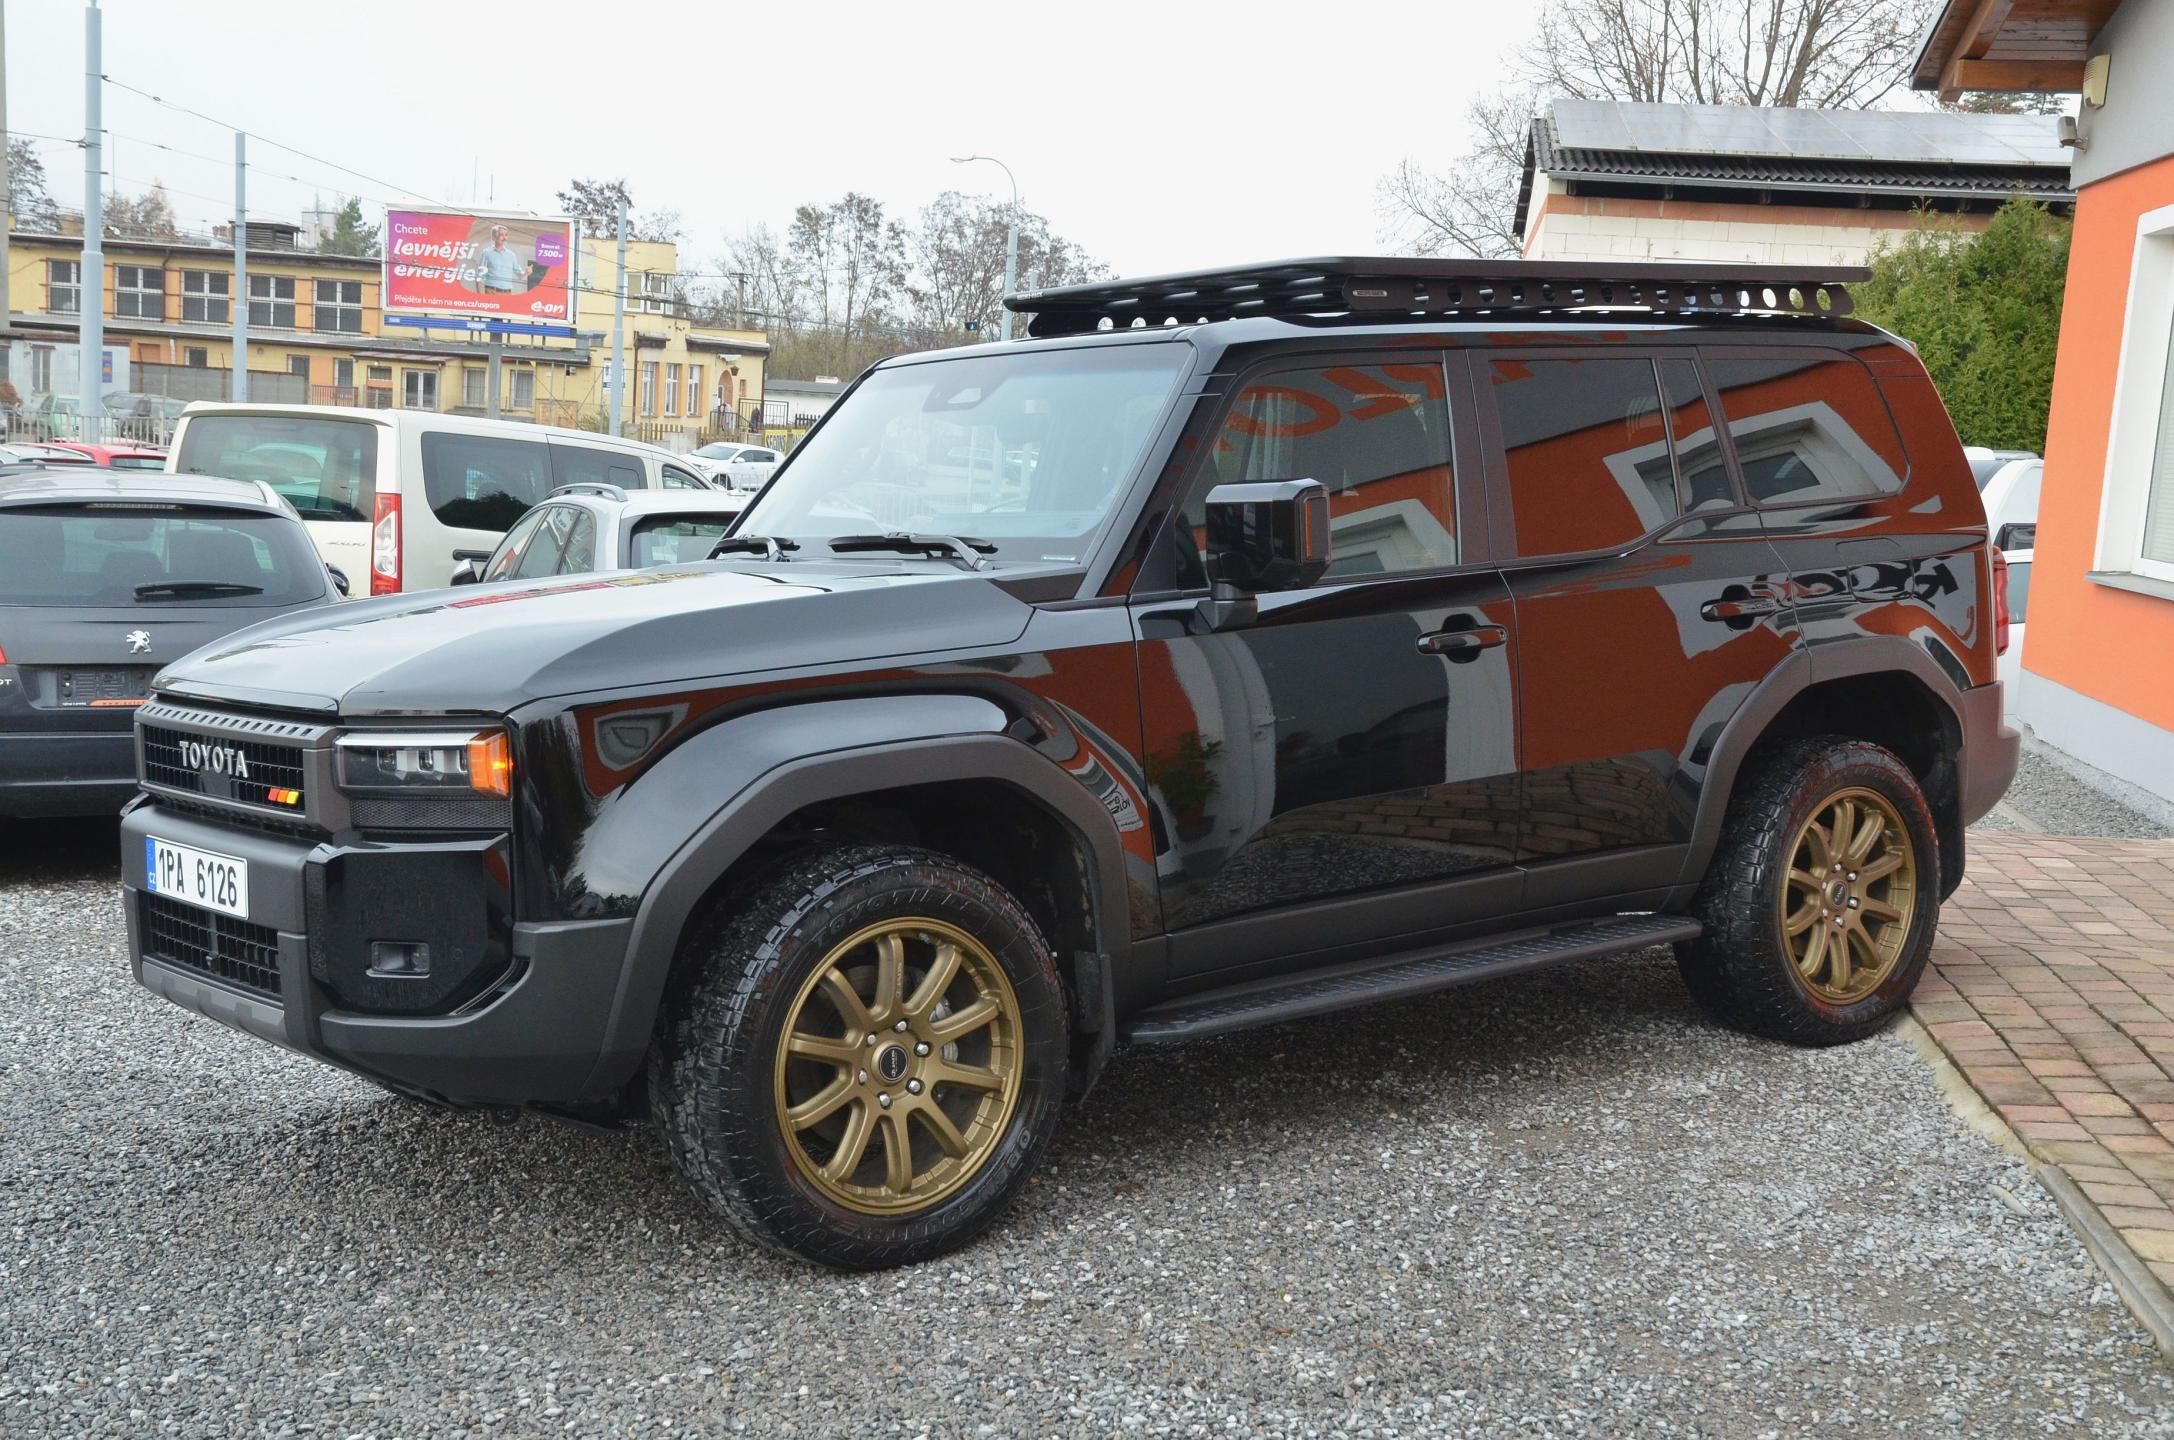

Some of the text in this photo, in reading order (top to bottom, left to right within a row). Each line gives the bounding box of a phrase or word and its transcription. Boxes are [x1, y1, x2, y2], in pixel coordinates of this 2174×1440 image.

[394, 223, 428, 235] Chcete
[393, 239, 479, 262] levnější
[394, 263, 488, 284] energie?
[428, 297, 444, 305] nám
[179, 740, 249, 778] TOYOTA
[159, 848, 184, 893] 1PA
[197, 858, 237, 907] 6126
